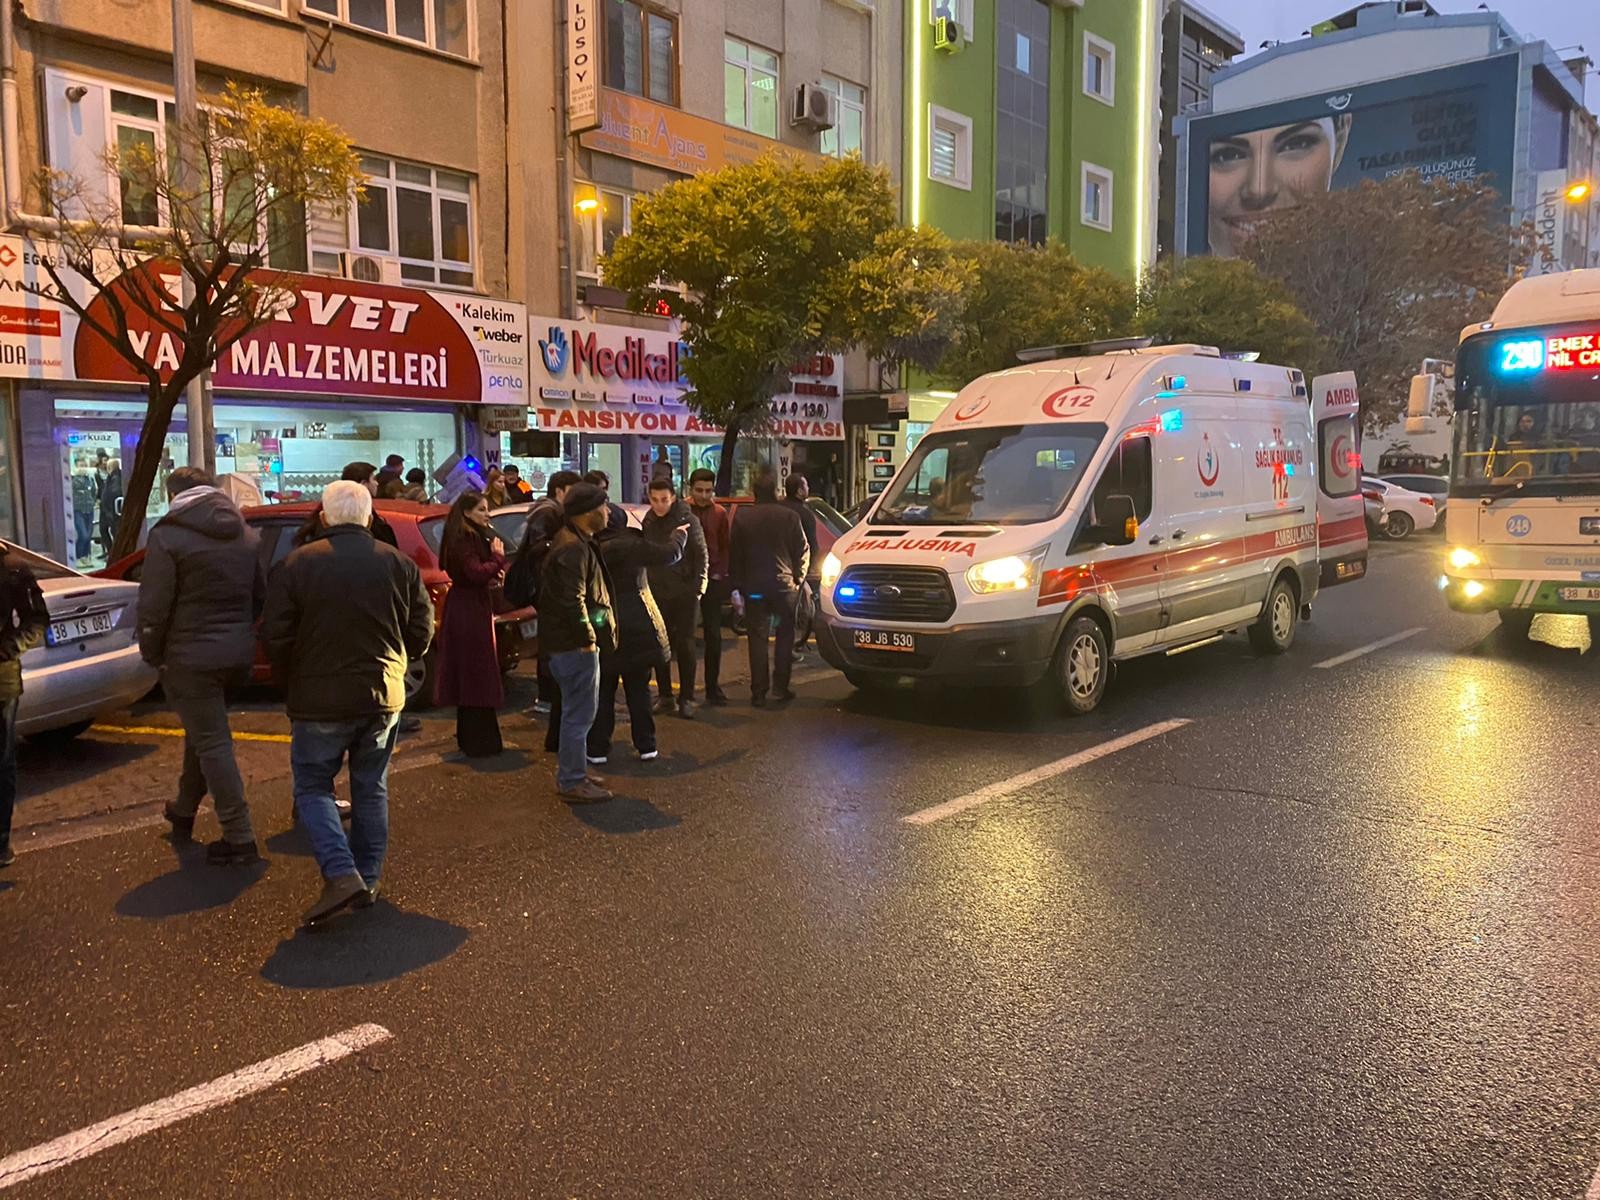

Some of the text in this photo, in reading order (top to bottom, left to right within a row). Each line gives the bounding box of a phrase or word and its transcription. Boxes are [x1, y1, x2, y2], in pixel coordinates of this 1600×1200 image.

[651, 111, 708, 159] Ajans
[462, 303, 515, 323] Kalekim
[483, 328, 522, 343] weber
[1547, 335, 1594, 353] EMEK
[231, 338, 448, 388] MALZEMELERİ
[1502, 339, 1544, 371] 290
[1548, 350, 1575, 367] NİL
[488, 375, 523, 389] penta
[1056, 395, 1095, 408] 112
[1275, 525, 1315, 548] AMBULANS
[1566, 588, 1578, 599] 38
[53, 623, 68, 640] 38
[75, 620, 88, 635] YS
[858, 631, 871, 644] 38
[893, 634, 913, 647] 530
